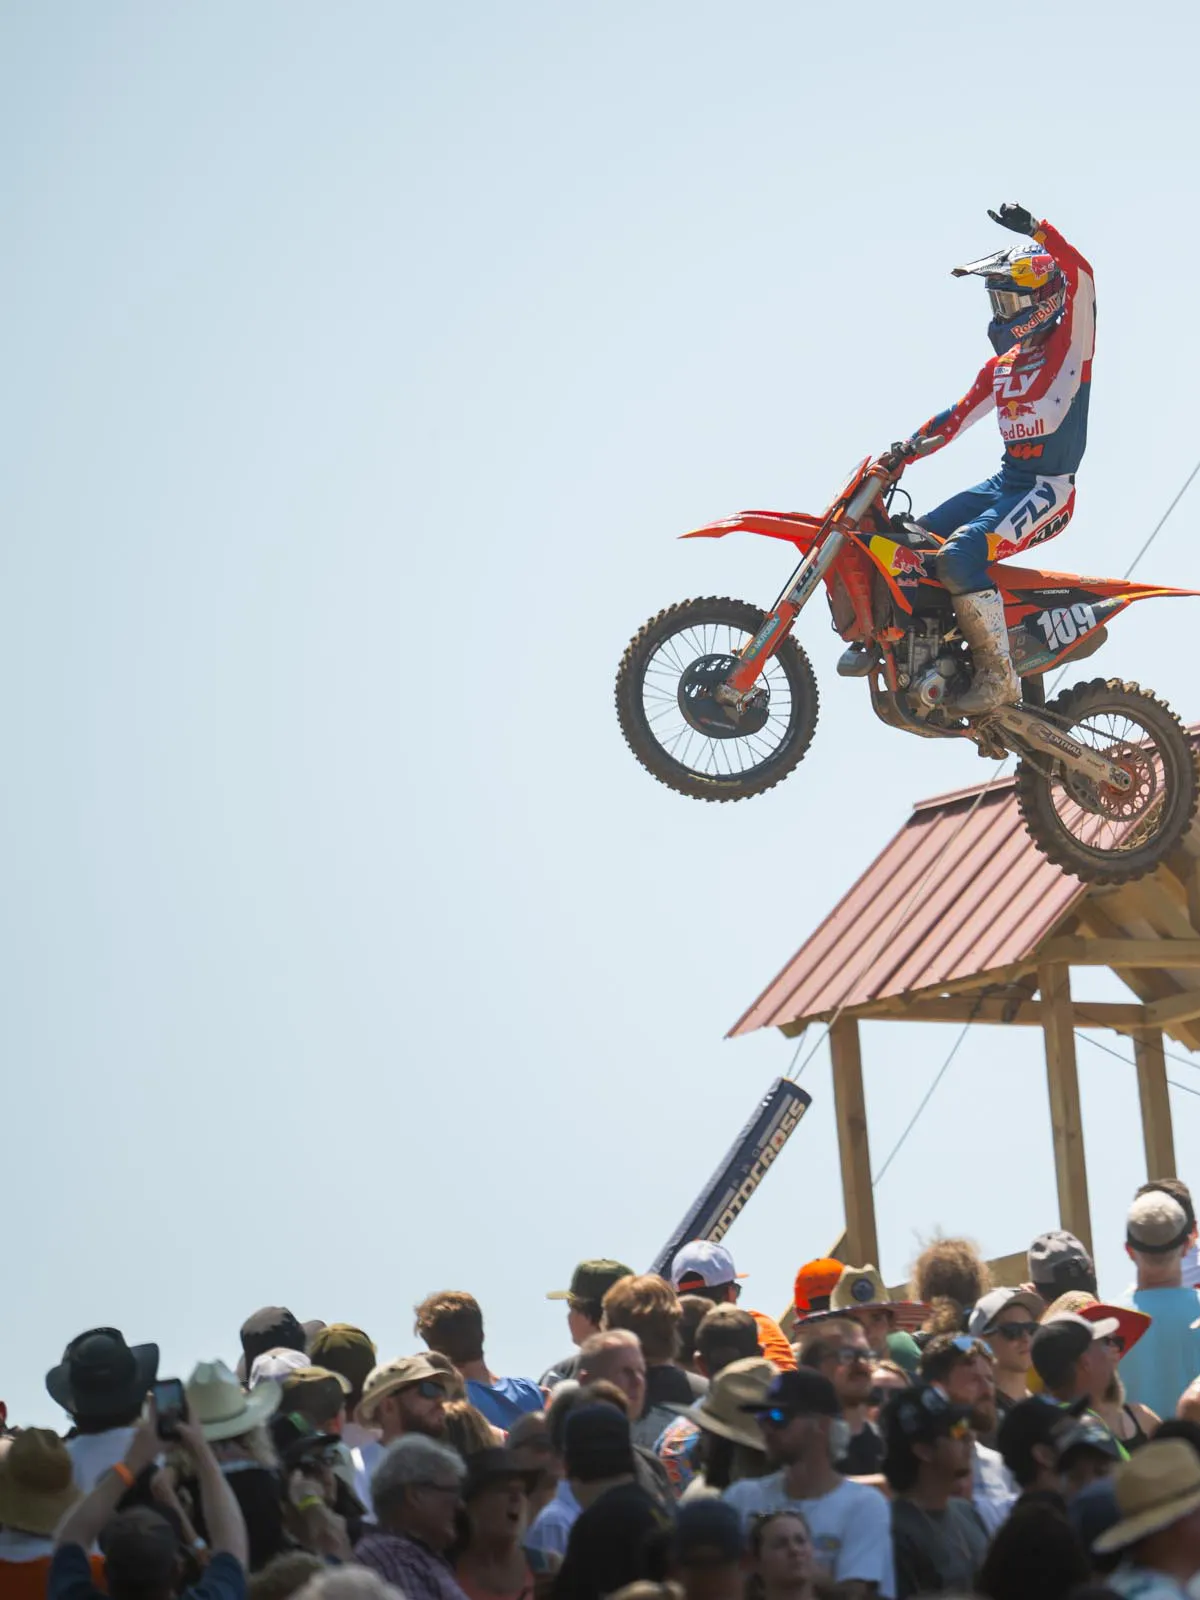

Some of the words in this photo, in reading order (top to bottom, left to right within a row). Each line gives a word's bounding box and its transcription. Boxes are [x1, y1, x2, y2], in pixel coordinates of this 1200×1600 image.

[993, 369, 1041, 399] FLY
[1016, 419, 1044, 438] Bull
[1010, 481, 1056, 540] FLY
[1027, 512, 1069, 548] KTM
[1037, 603, 1096, 651] 109
